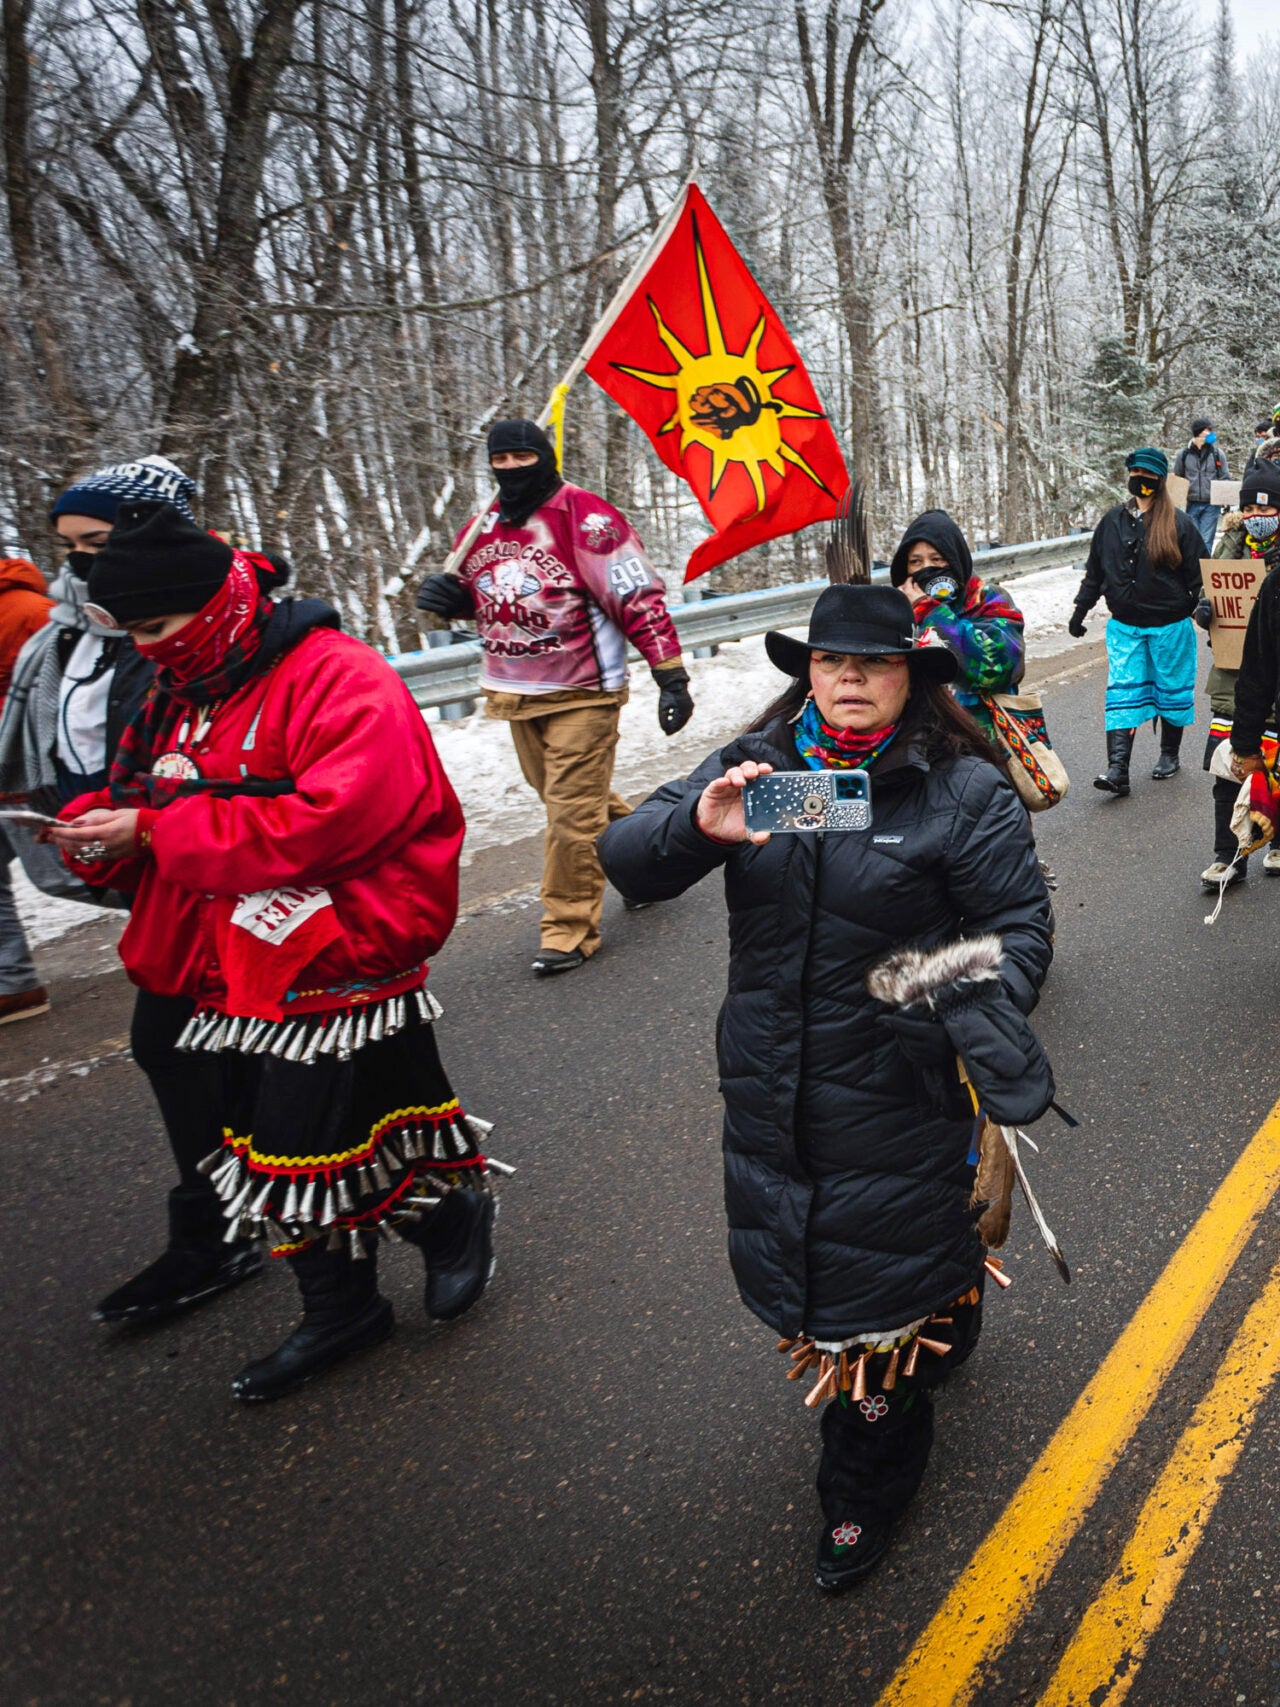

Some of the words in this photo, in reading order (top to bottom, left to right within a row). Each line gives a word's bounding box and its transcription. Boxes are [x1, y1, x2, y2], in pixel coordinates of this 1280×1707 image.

[520, 544, 574, 587] CREEK
[610, 557, 650, 596] 99
[1210, 572, 1256, 590] STOP
[1213, 596, 1245, 619] LINE
